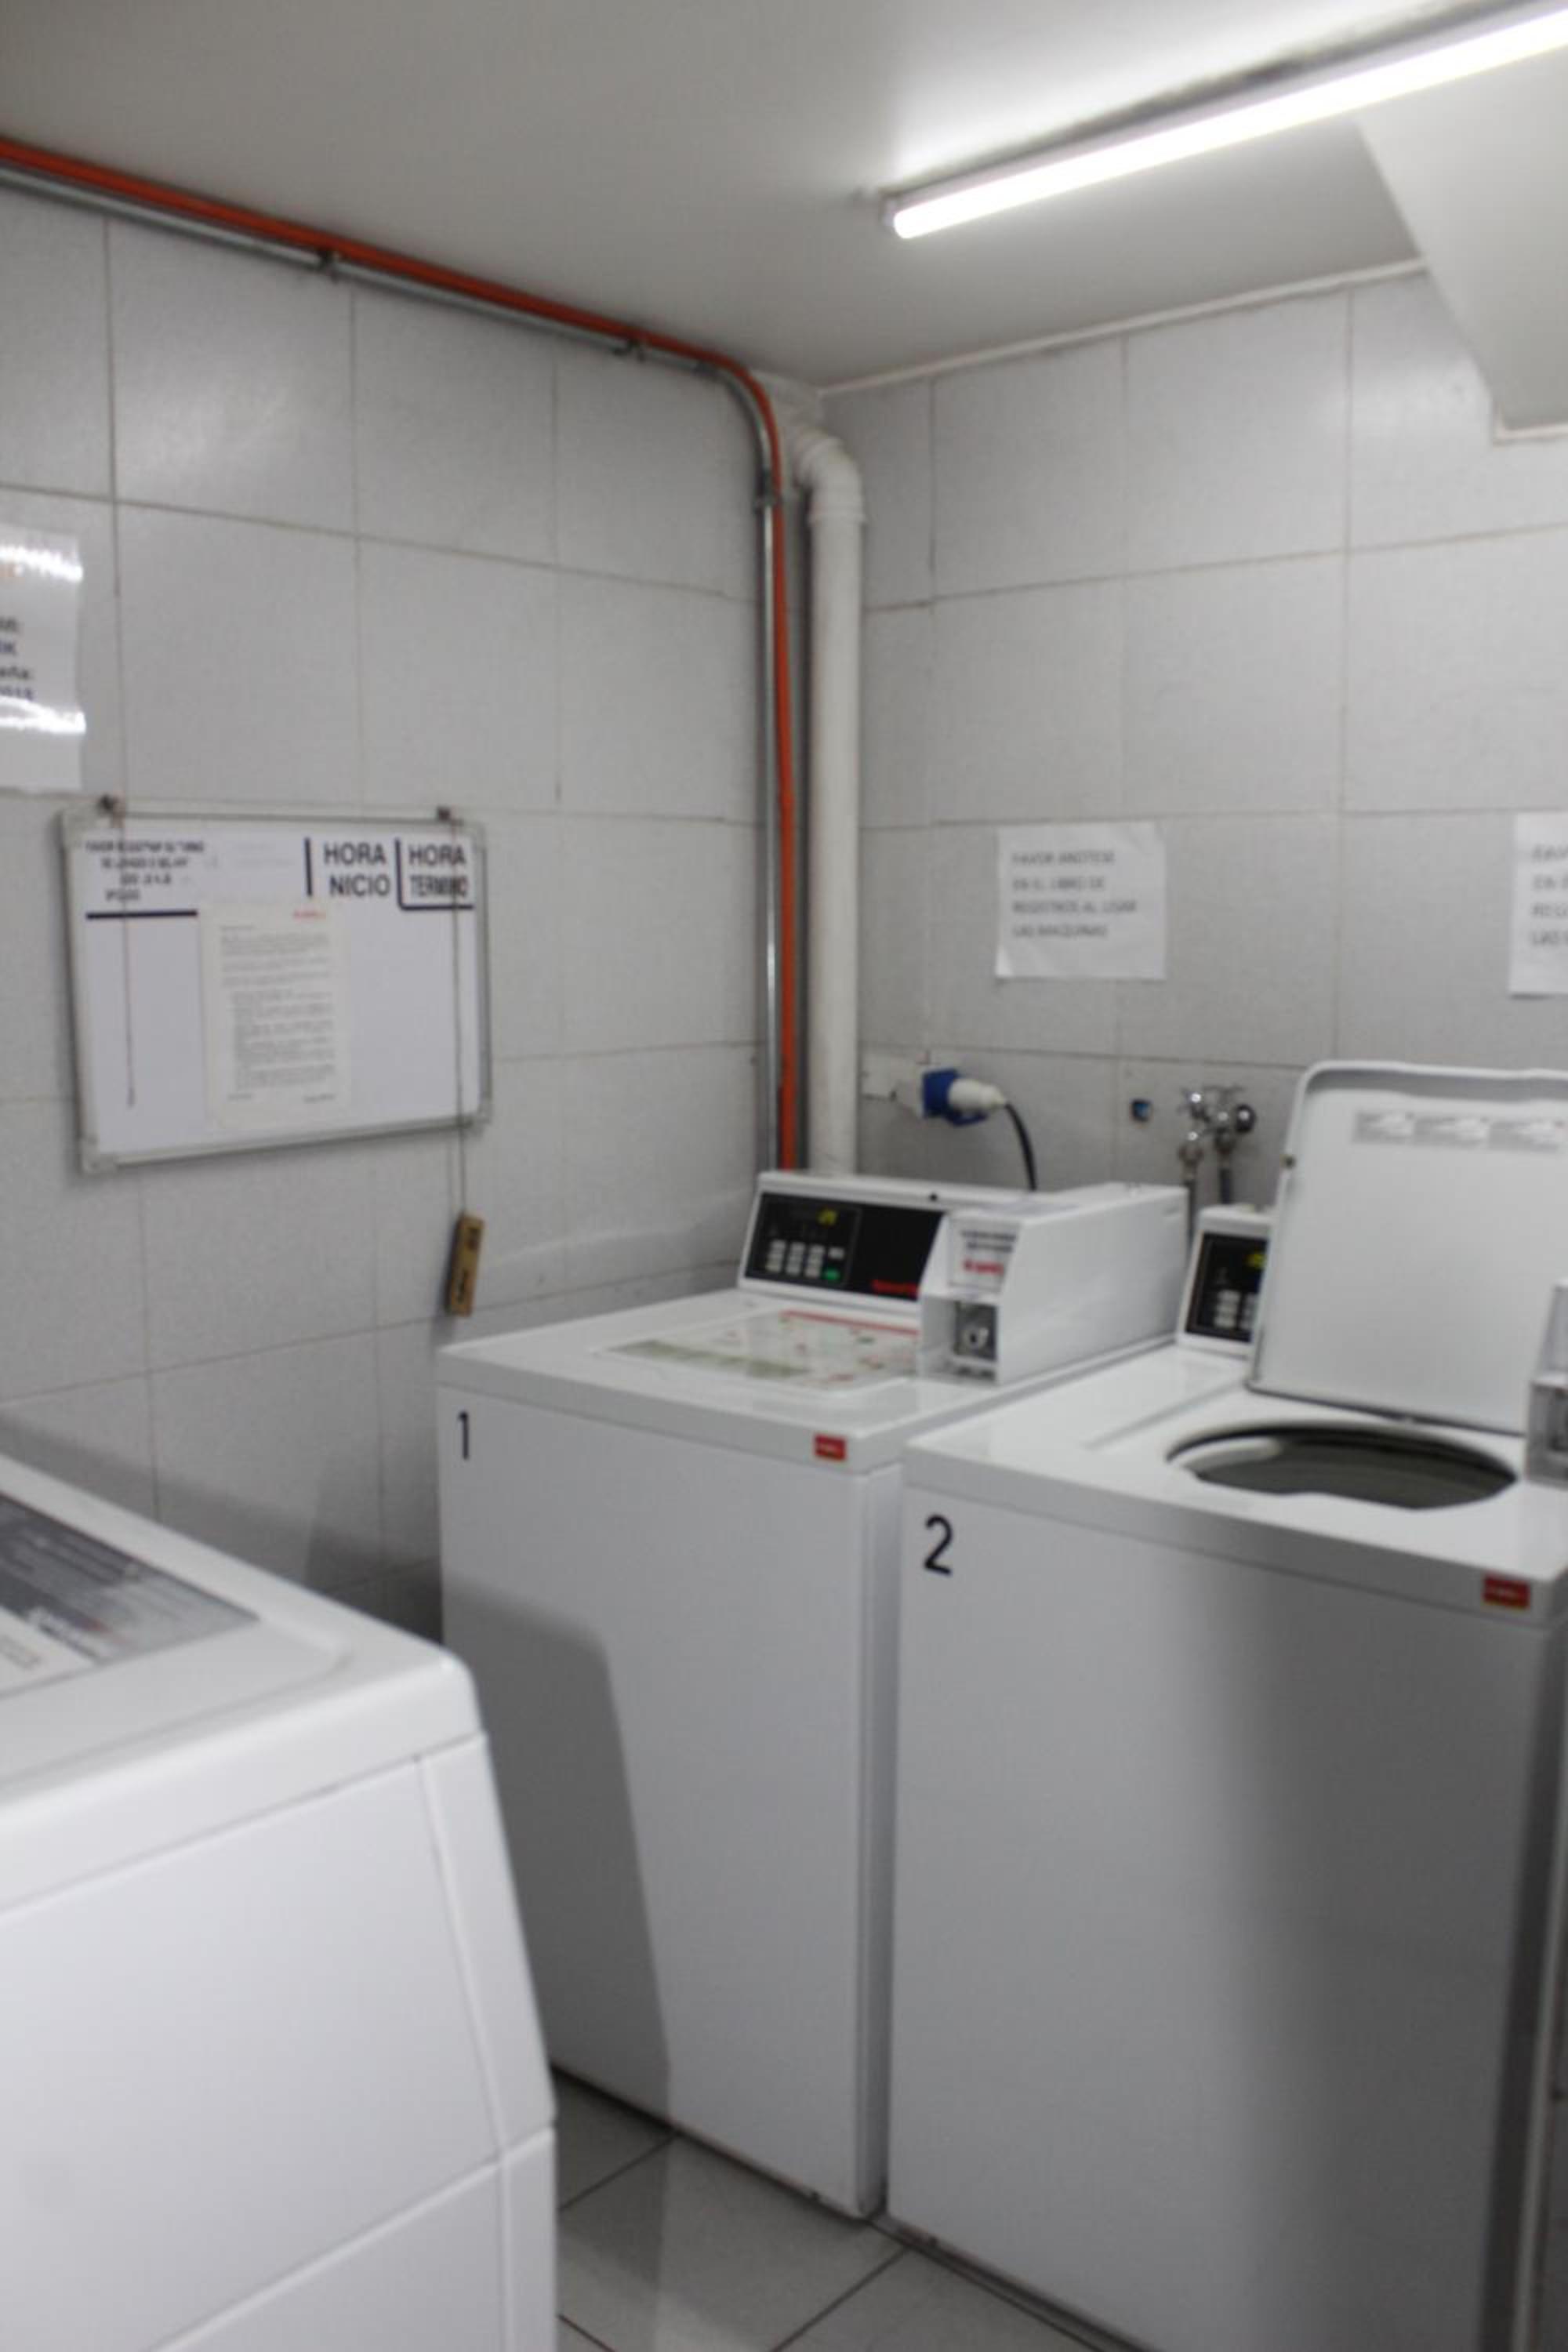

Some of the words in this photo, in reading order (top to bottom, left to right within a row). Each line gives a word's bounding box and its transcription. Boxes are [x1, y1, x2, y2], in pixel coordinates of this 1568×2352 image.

[324, 842, 387, 866] HORA
[408, 844, 466, 866] HORA
[329, 874, 390, 897] NICIO
[456, 1410, 470, 1461] 1
[924, 1514, 953, 1576] 2
